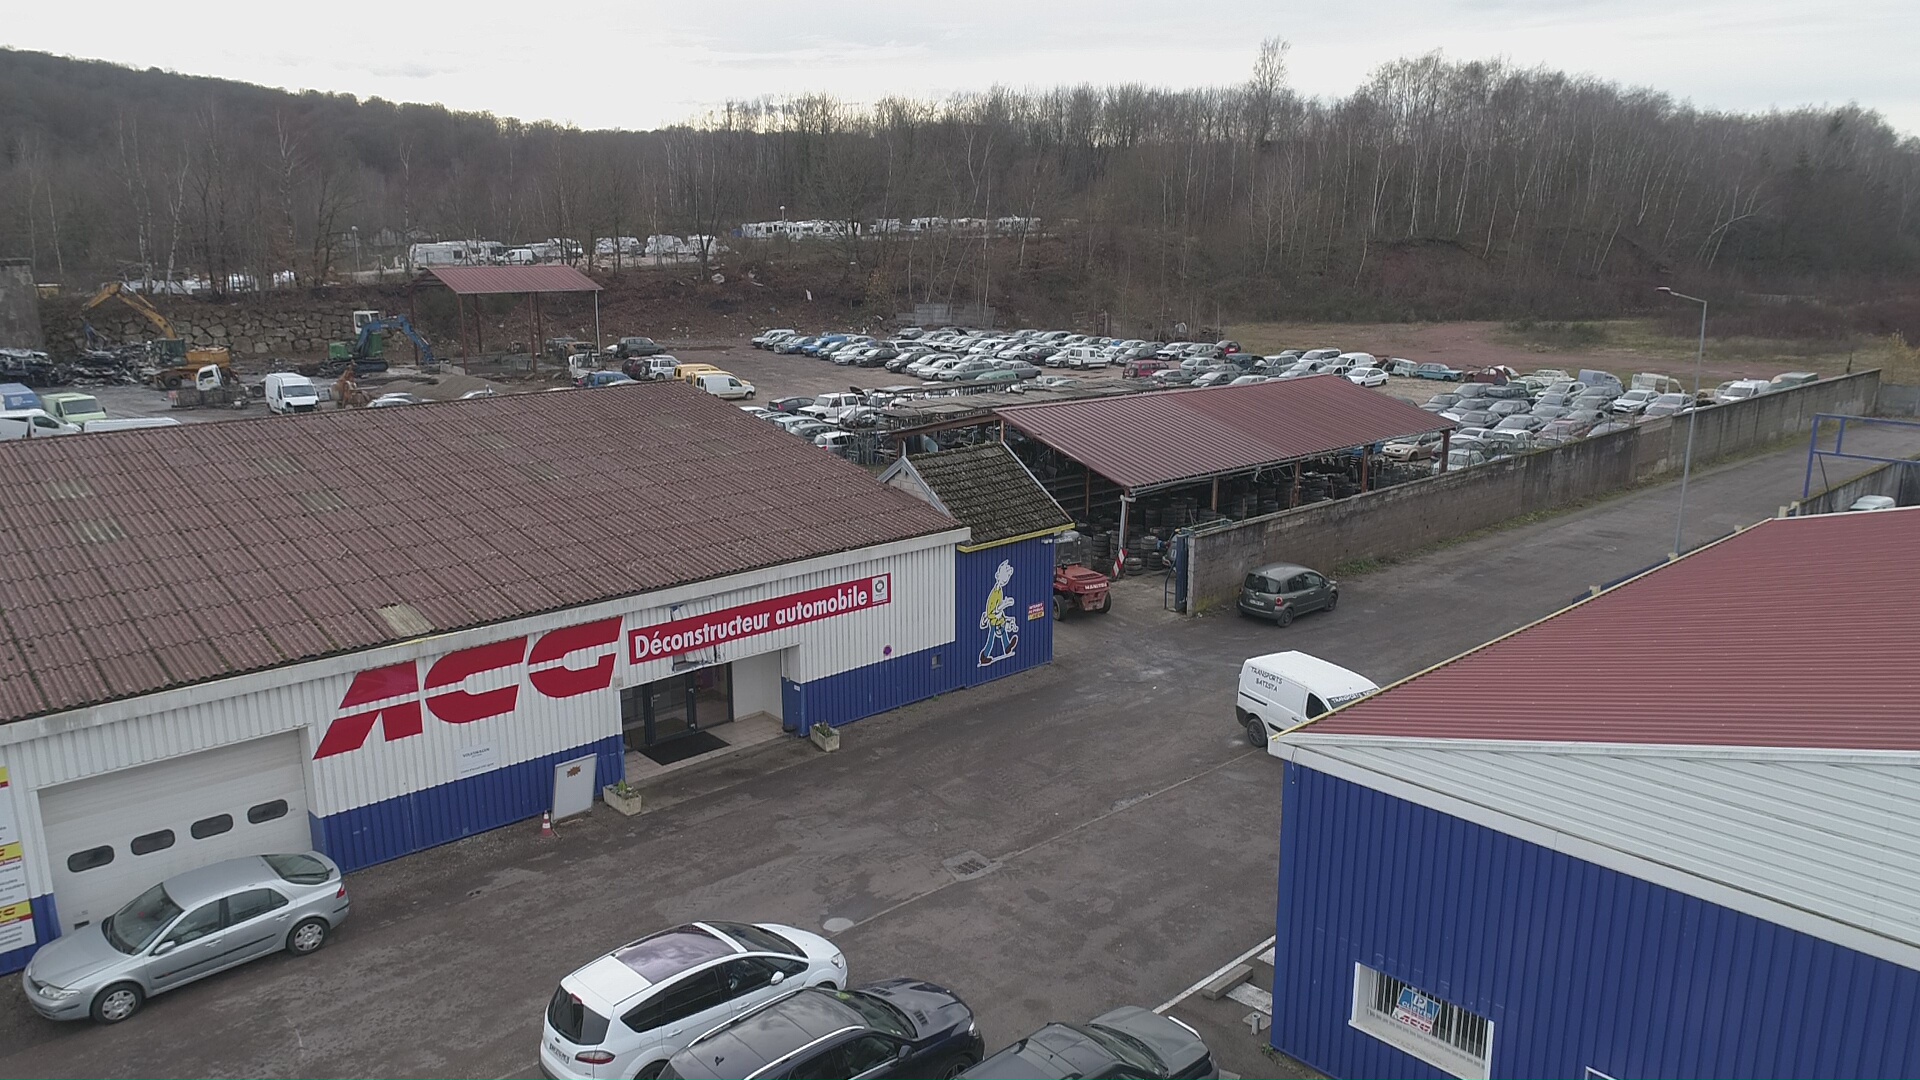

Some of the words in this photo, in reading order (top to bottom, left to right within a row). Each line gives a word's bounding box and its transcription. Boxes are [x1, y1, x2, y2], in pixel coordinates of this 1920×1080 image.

[634, 611, 770, 659] Déconstructeur
[775, 586, 868, 626] automobile
[1250, 666, 1283, 684] TRANSPORTS
